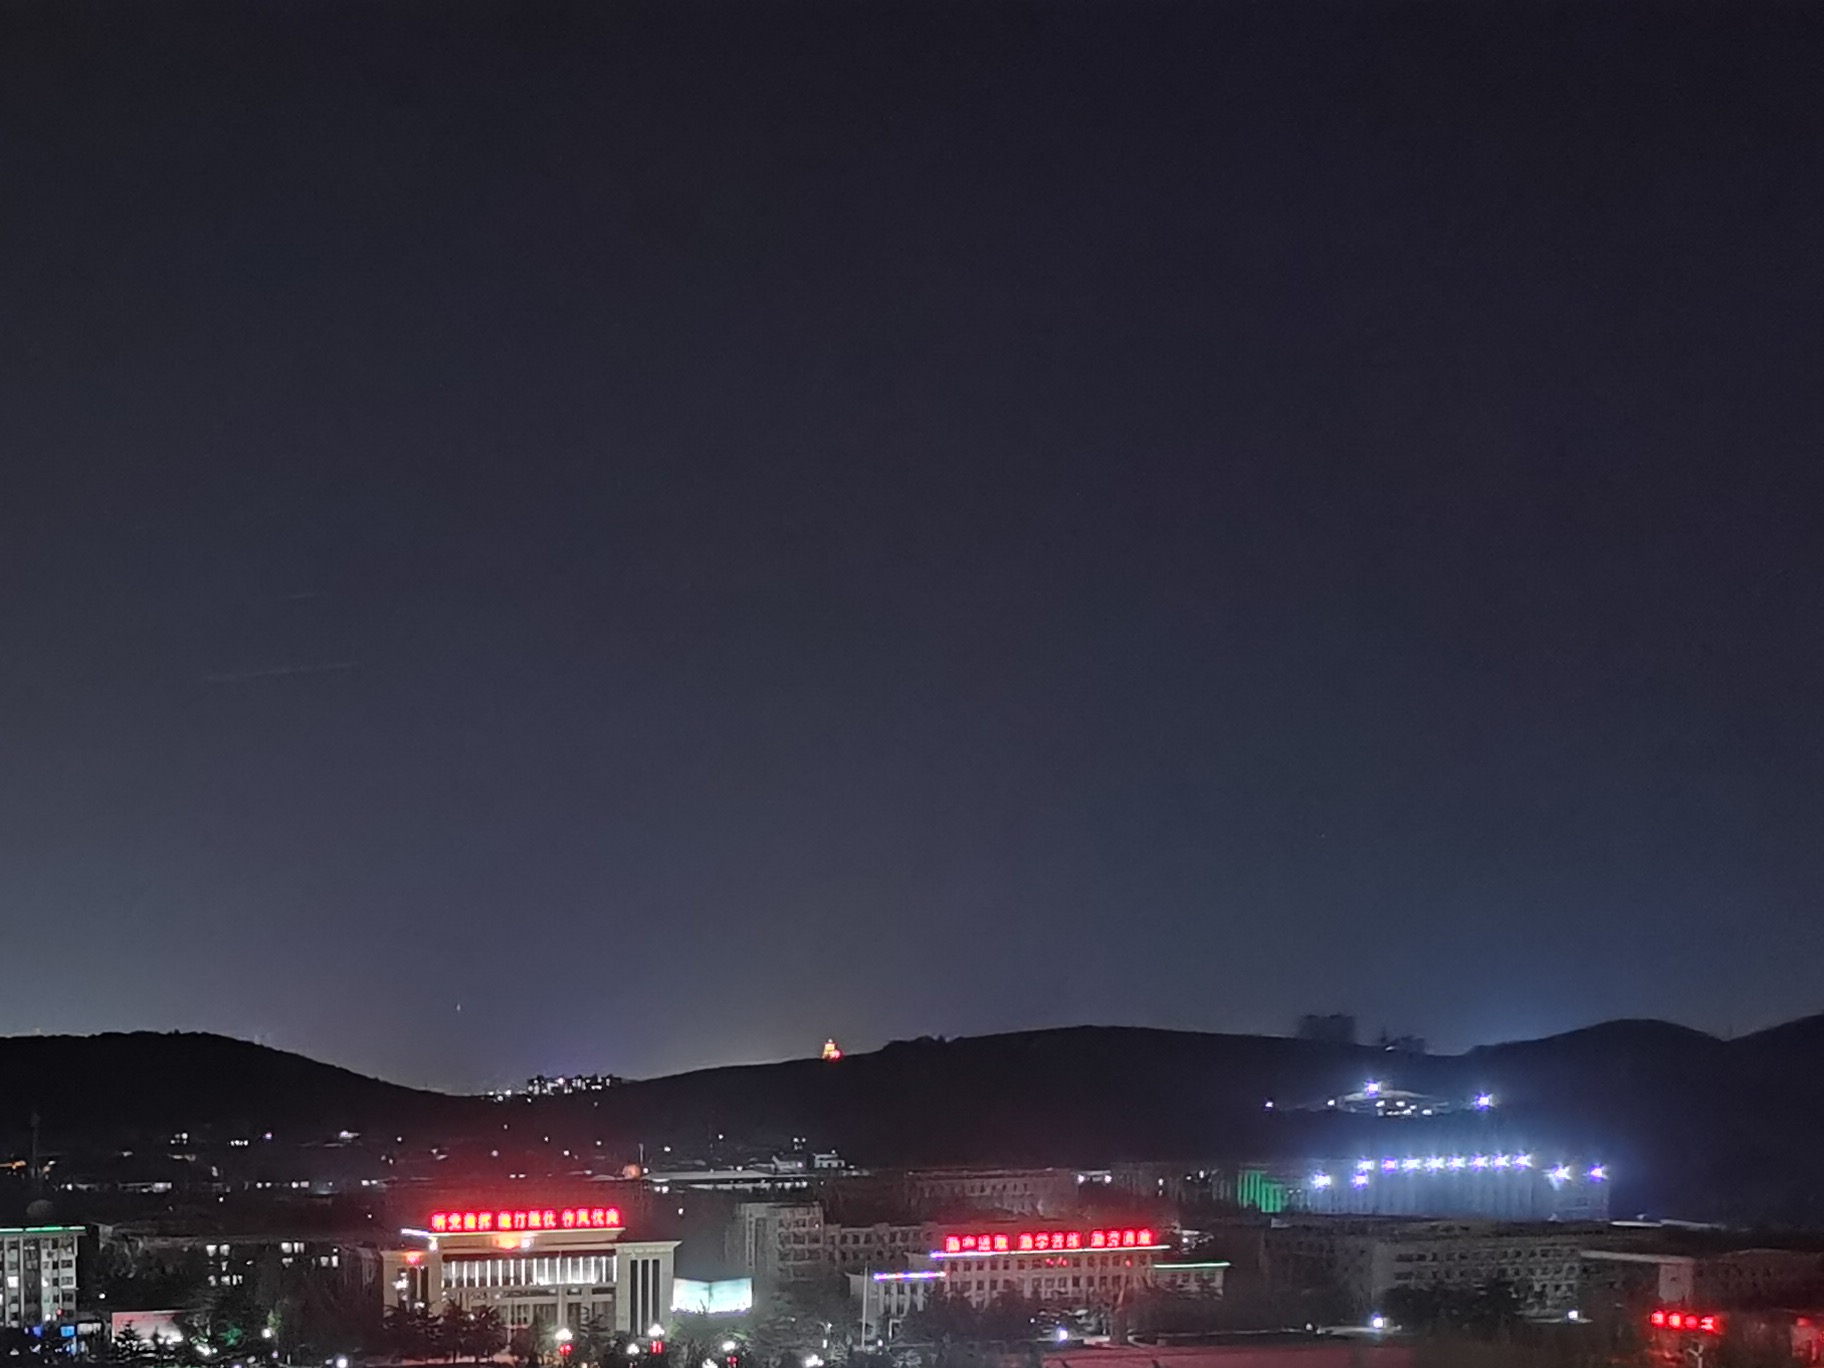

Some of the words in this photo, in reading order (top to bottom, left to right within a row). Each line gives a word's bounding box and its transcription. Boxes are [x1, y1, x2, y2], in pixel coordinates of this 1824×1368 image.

[497, 1210, 557, 1229] 能打胜仗
[562, 1208, 619, 1228] 作风优良
